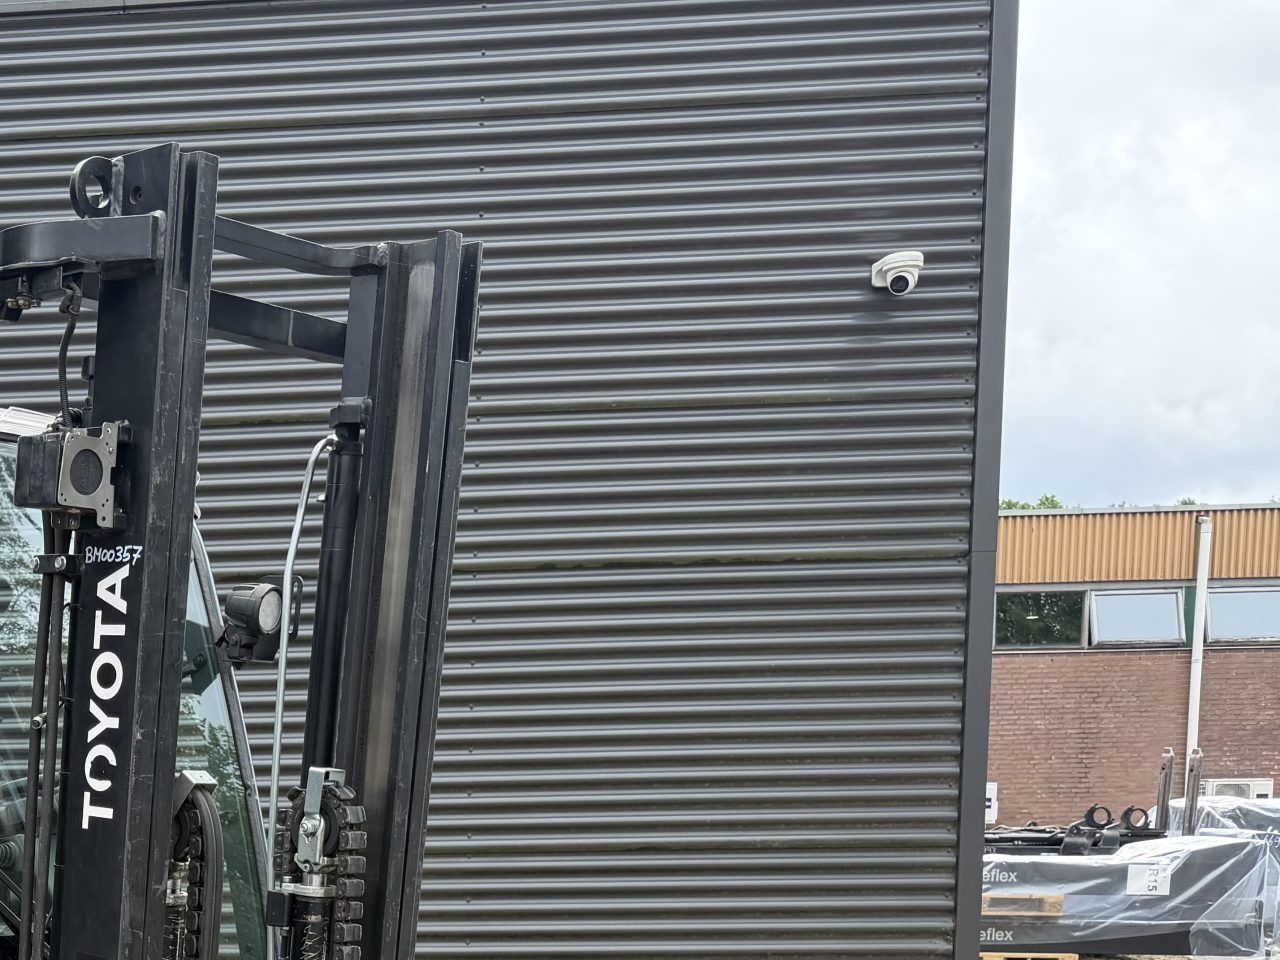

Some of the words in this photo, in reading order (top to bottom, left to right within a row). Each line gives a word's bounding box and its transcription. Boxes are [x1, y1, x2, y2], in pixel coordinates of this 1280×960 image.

[85, 545, 143, 566] BM00357
[81, 563, 130, 830] TOYOTA
[1146, 867, 1159, 893] R15
